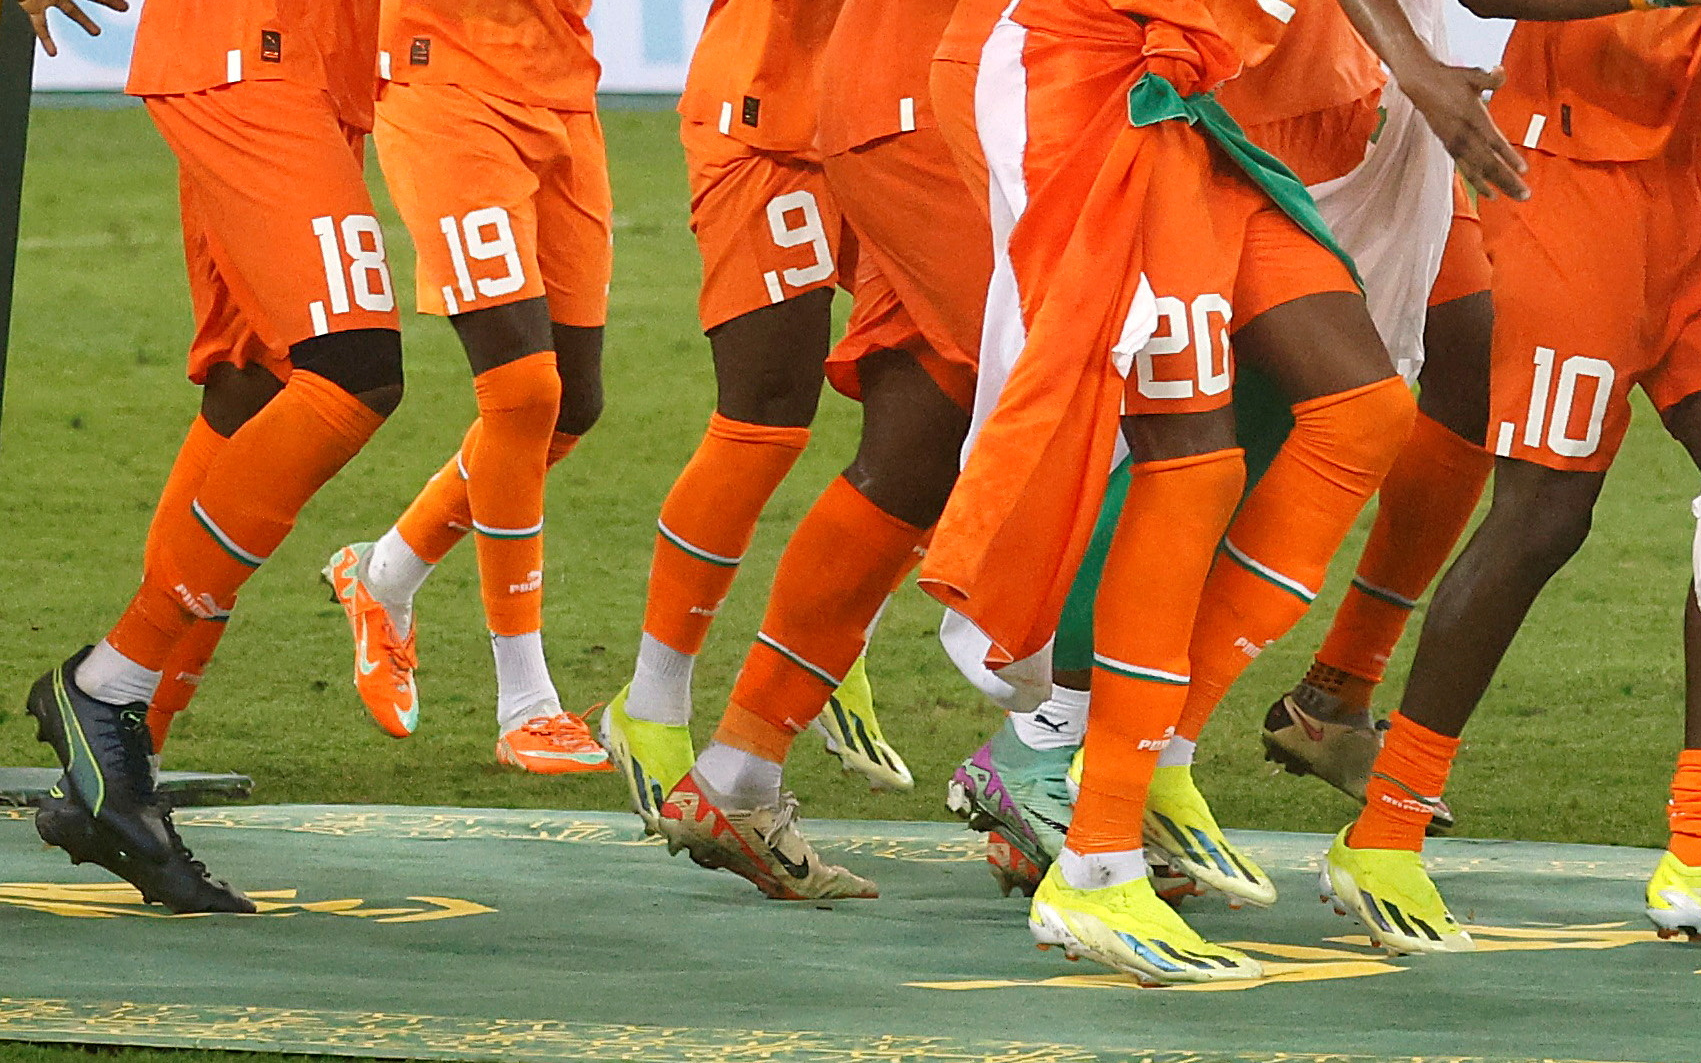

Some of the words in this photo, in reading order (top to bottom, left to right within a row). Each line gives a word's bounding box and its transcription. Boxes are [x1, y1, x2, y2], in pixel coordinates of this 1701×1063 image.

[311, 214, 395, 315] 18
[439, 206, 526, 303] 19
[766, 189, 835, 288] 9
[1136, 293, 1233, 399] 20
[1523, 346, 1615, 458] 10
